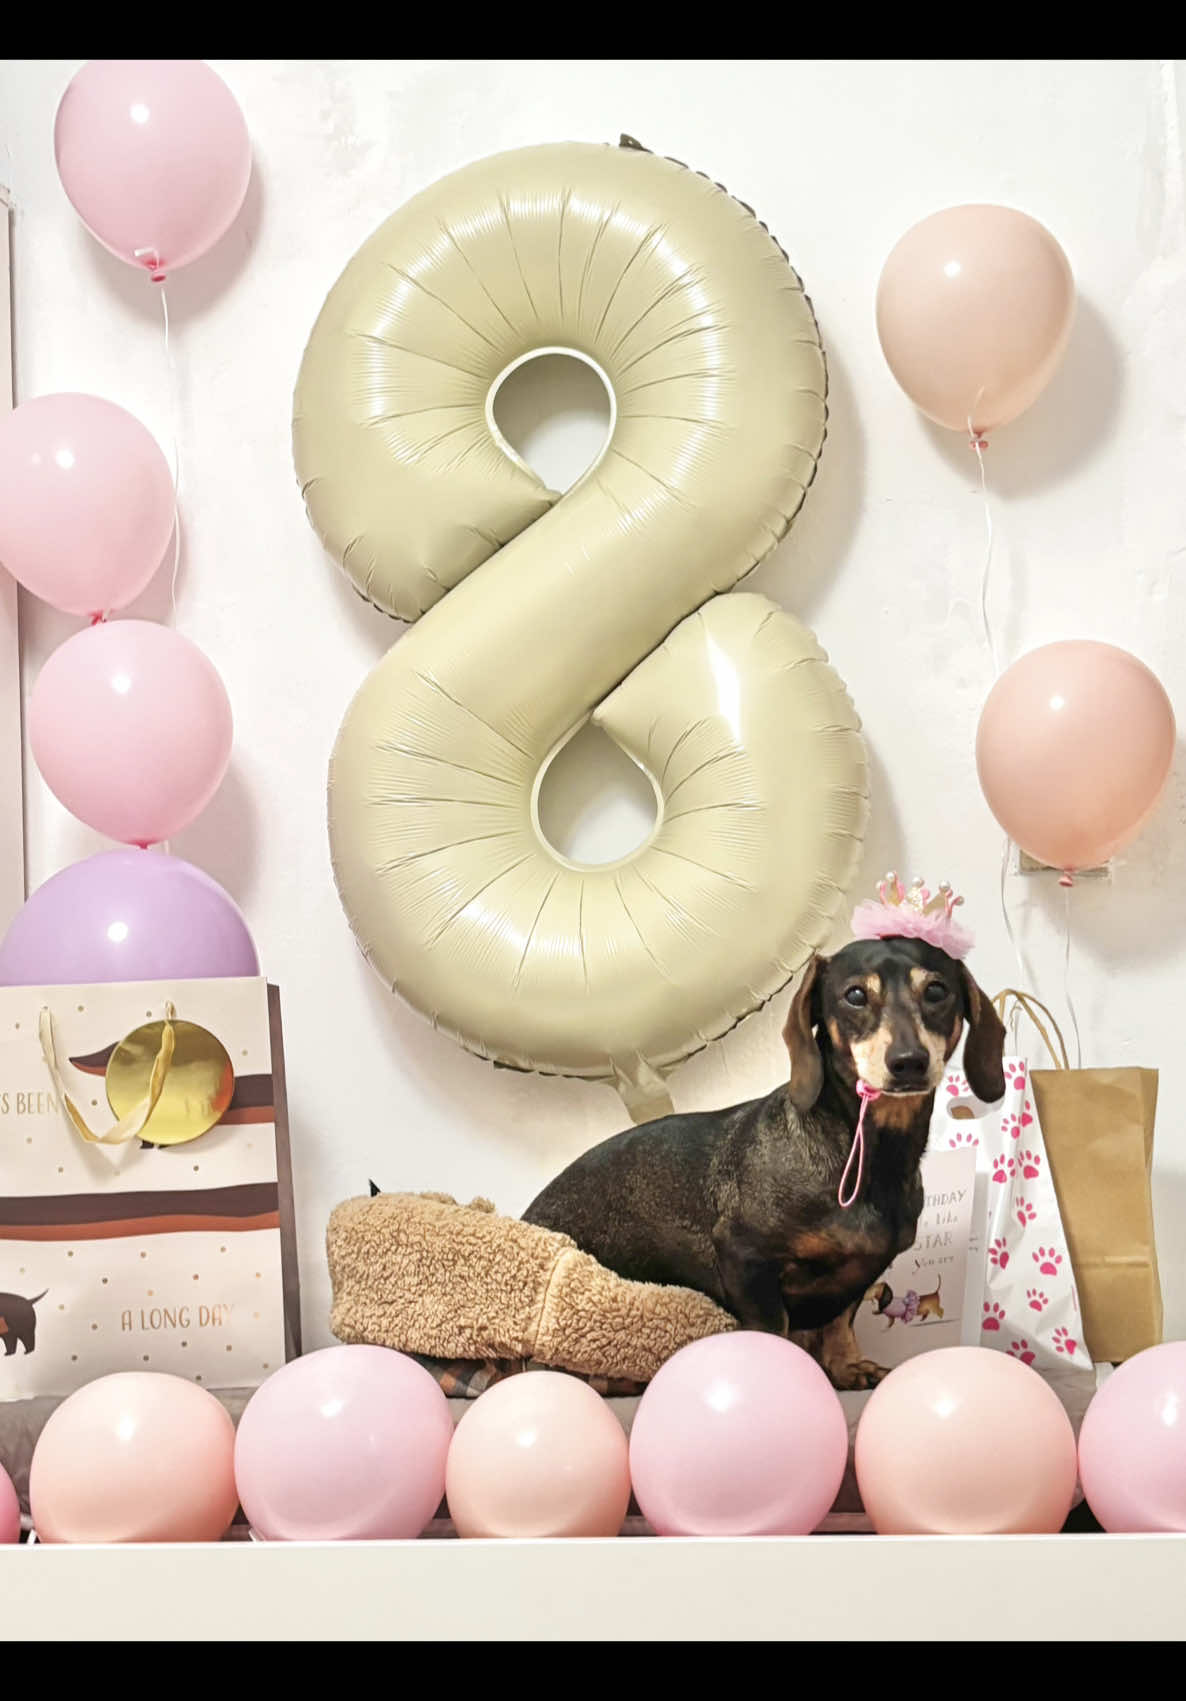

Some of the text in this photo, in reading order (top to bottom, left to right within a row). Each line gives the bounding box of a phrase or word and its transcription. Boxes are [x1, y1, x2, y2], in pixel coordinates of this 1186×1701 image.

[16, 1092, 58, 1115] BEEN
[924, 1189, 967, 1207] THDAY
[121, 1304, 235, 1332] A LONG DAY
